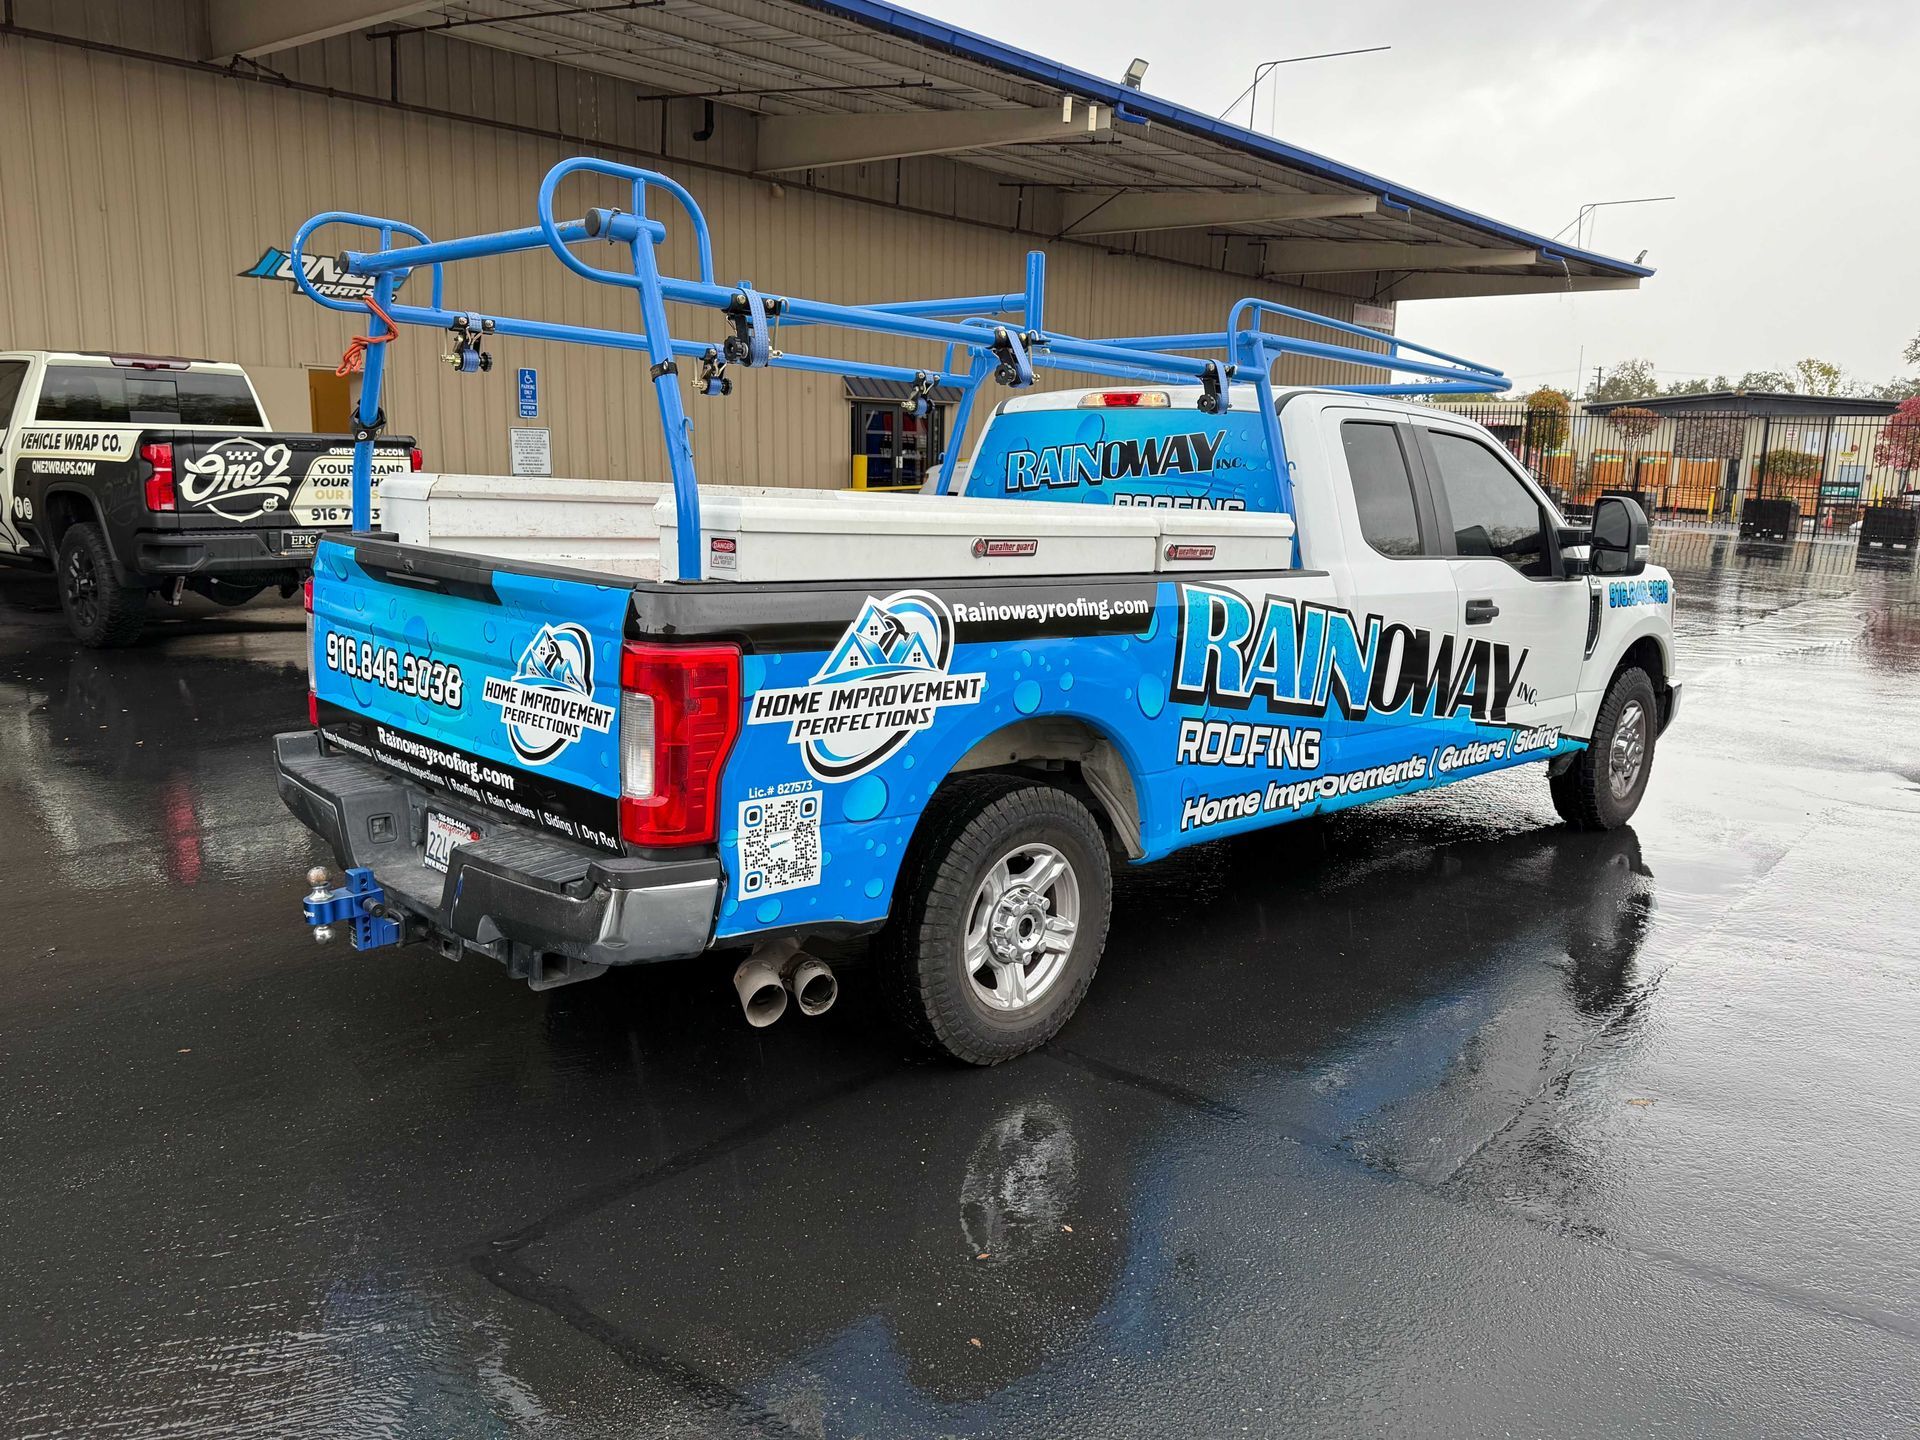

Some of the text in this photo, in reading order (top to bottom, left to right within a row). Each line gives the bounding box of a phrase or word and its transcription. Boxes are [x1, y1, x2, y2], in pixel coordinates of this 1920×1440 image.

[20, 433, 122, 452] VEHICLE WRAP CO.
[31, 460, 97, 475] ONE2WRAPS.COM
[178, 443, 292, 502] One2
[370, 464, 404, 474] RAND
[1006, 431, 1247, 493] RAINOWAY INC.
[311, 477, 350, 488] YOUR
[314, 489, 345, 500] OUR
[291, 535, 317, 545] EPIC
[988, 542, 1035, 553] weather guard
[1177, 547, 1214, 557] weather guard
[952, 597, 1150, 624] Rainowayroofing.com
[1172, 582, 1539, 725] RAINOWAY INC.
[326, 632, 463, 708] 916.846.3038
[484, 681, 612, 729] HOME IMPROVEMENT
[755, 678, 982, 718] HOME IMPROVEMENT
[503, 706, 580, 738] PERFECTIONS
[794, 707, 932, 738] PERFECTIONS
[376, 726, 515, 791] Rainowayroofing.com
[1176, 719, 1322, 769] ROOFING
[748, 779, 813, 799] Lic.# 827573
[1180, 792, 1261, 830] Home
[1263, 754, 1427, 811] Improvements
[1437, 738, 1507, 773] Gutters
[1513, 726, 1561, 754] Siding
[450, 777, 481, 802] Roofing
[486, 791, 507, 809] Rain
[505, 798, 536, 819] Gutters
[543, 811, 573, 836] Siding
[581, 824, 599, 845] Dry
[599, 831, 619, 850] Rot
